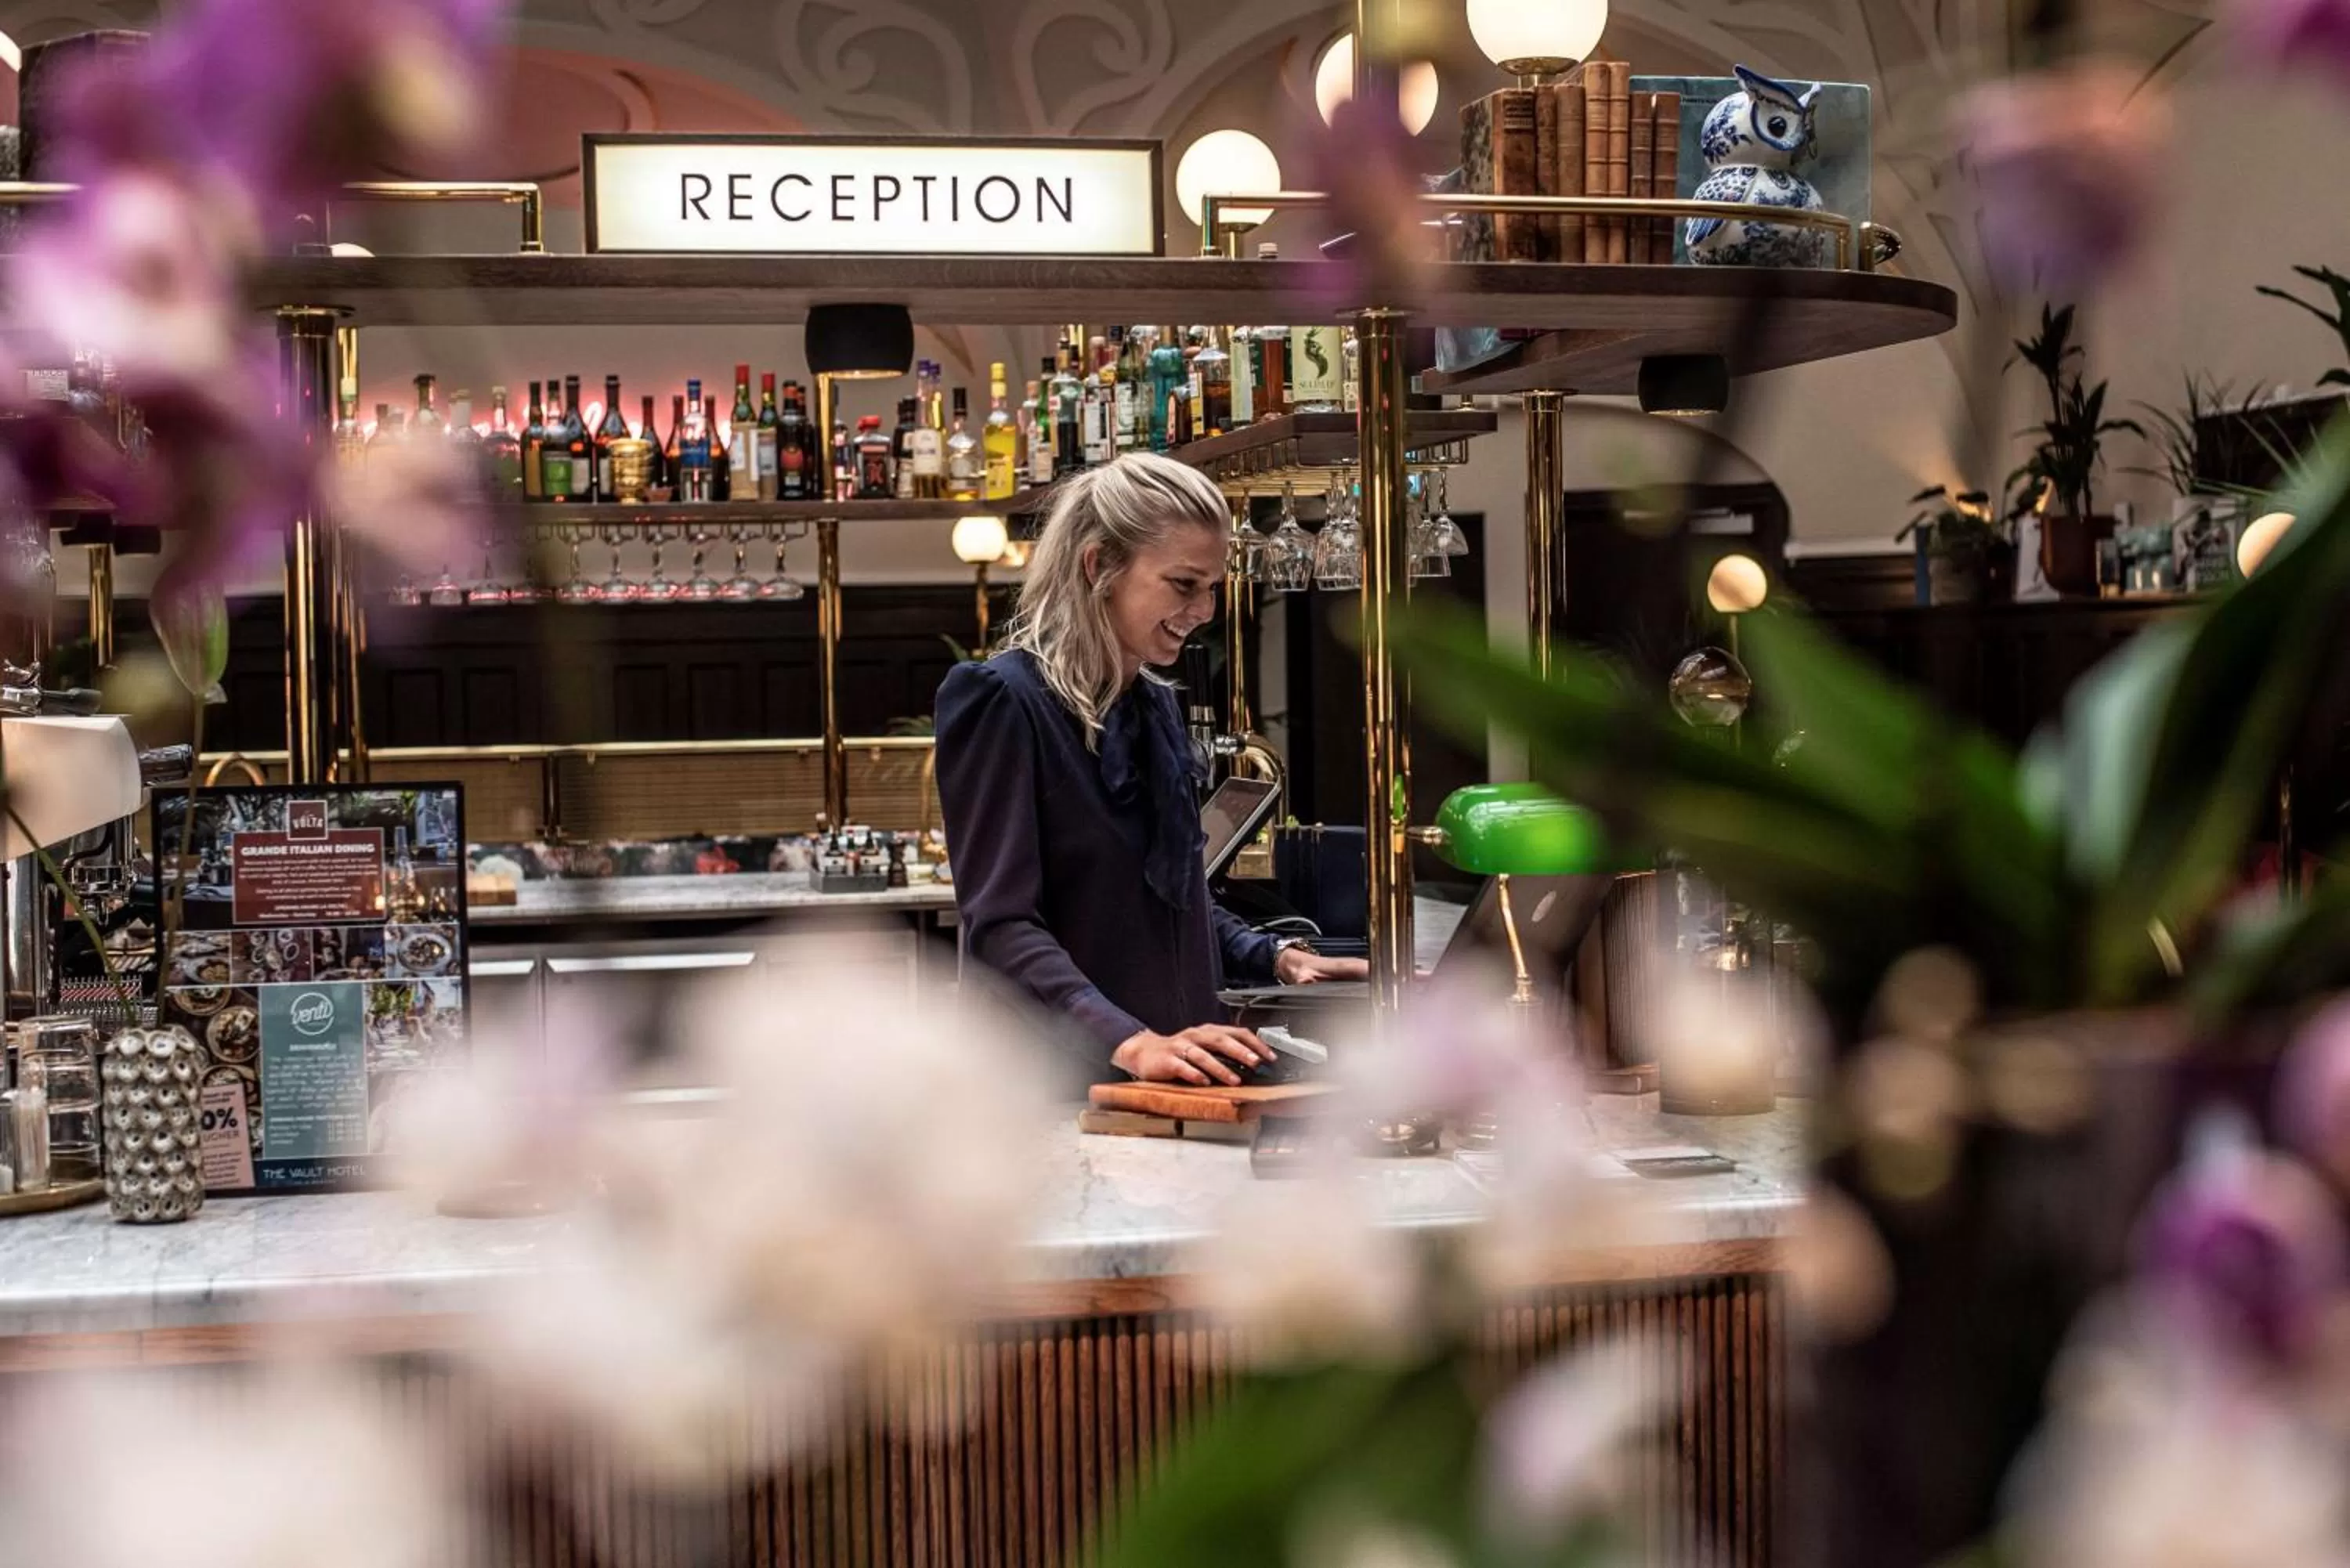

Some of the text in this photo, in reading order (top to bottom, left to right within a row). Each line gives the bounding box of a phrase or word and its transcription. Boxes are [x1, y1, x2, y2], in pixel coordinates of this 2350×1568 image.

[681, 172, 1072, 223] RECEPTION
[240, 843, 375, 856] GRANDE ITALIAN DINING
[201, 1106, 238, 1130] 0%
[202, 1130, 240, 1142] UCHER
[262, 1165, 365, 1179] THE VAULT HOTEL
